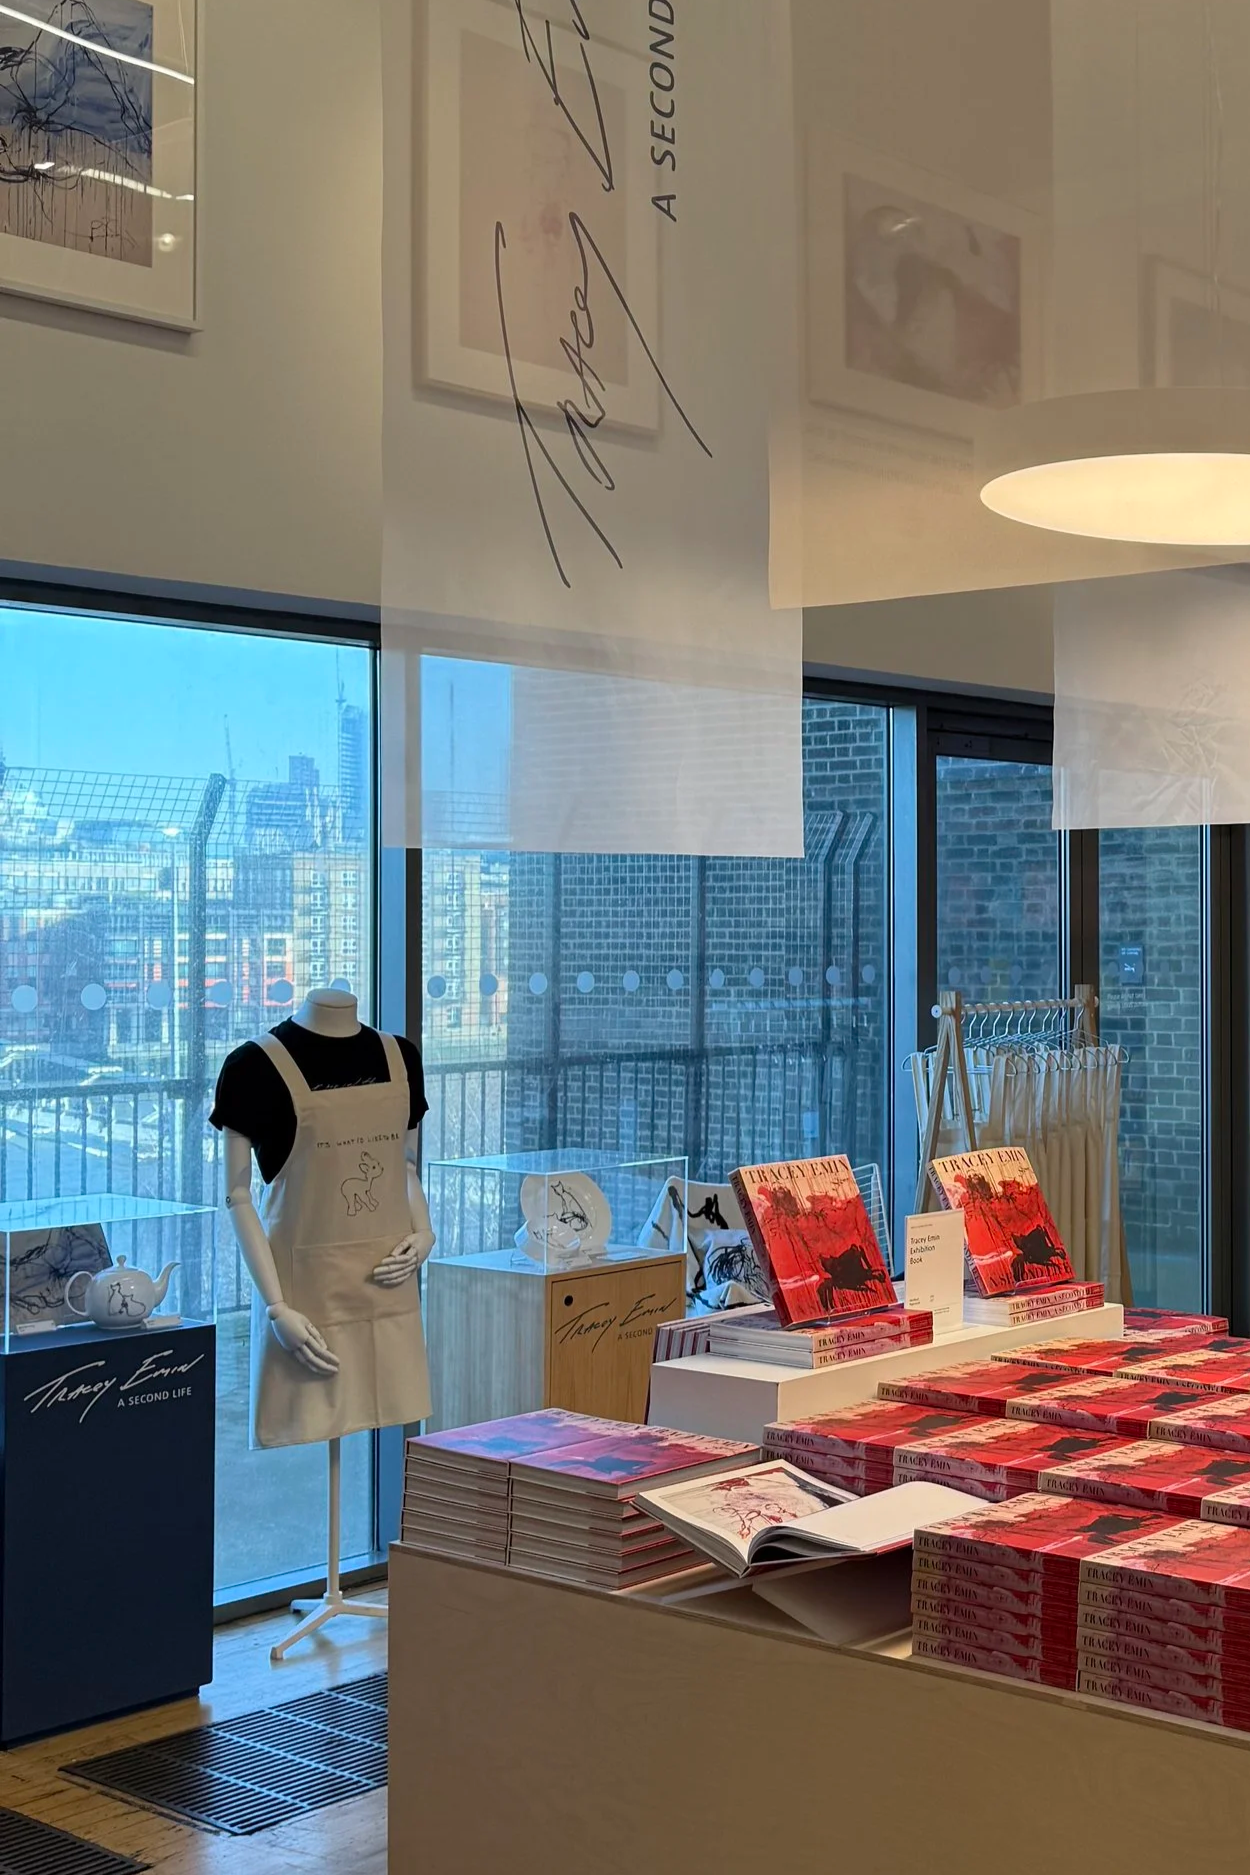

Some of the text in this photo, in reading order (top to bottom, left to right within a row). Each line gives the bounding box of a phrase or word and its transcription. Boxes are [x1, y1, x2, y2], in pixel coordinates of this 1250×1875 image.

[649, 0, 677, 222] A SECOND
[938, 1149, 1025, 1173] TRACEY EMIN
[745, 1159, 850, 1184] TRACEY EMIN
[928, 1166, 945, 1197] TRACEY
[732, 1175, 757, 1236] TRACEY EMIN
[910, 1234, 940, 1245] Tracey Emin
[910, 1244, 935, 1254] Exhibition
[910, 1256, 923, 1265] Book
[999, 1266, 1046, 1286] SEOND
[1012, 1299, 1034, 1310] TRACEY
[1036, 1297, 1050, 1305] EMIN
[625, 1328, 653, 1339] SECOND
[818, 1331, 865, 1347] TRACEY EMIN
[819, 1347, 866, 1364] TRACEY EMIN
[117, 1386, 192, 1408] A SECOND LIFE
[881, 1387, 929, 1401] TRACEY EMIN
[1011, 1406, 1062, 1420] TRACEY EMIN
[765, 1431, 814, 1447] TRACEY EMIN
[1154, 1426, 1212, 1442] TRACEY EMIN
[898, 1454, 951, 1471] TRACEY EMIN
[1046, 1479, 1104, 1497] TRACEY EMIN
[1205, 1505, 1243, 1520] TRACEY
[918, 1536, 979, 1556] TRACEY EMIN
[918, 1558, 978, 1577] TRACEY EMIN
[1086, 1567, 1153, 1588] TRACEY EMIN
[917, 1579, 977, 1599] TRACEY EMIN
[1086, 1590, 1152, 1611] TRACEY EMIN
[1083, 1613, 1151, 1635] TRACEY EMIN
